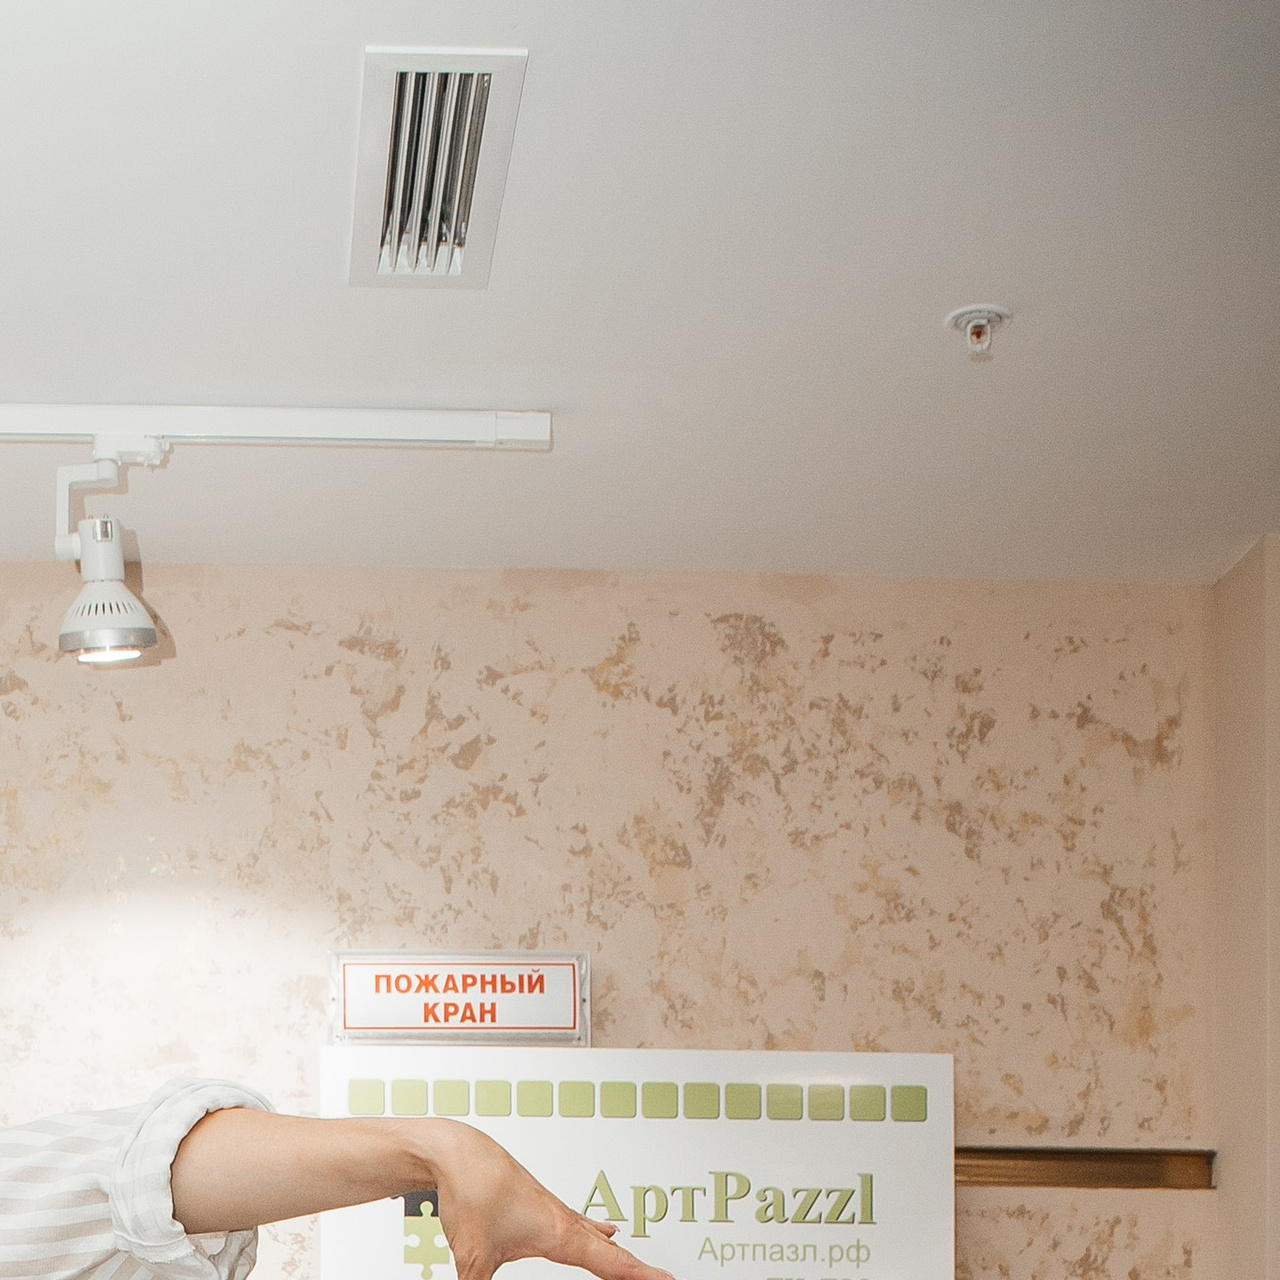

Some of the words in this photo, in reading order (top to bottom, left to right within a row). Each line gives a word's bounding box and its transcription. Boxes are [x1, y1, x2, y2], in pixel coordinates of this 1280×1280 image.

[374, 968, 545, 995] ПОЖАРНЫЙ
[422, 1001, 497, 1024] КРАН
[698, 1238, 871, 1267] Артпазл.рф
